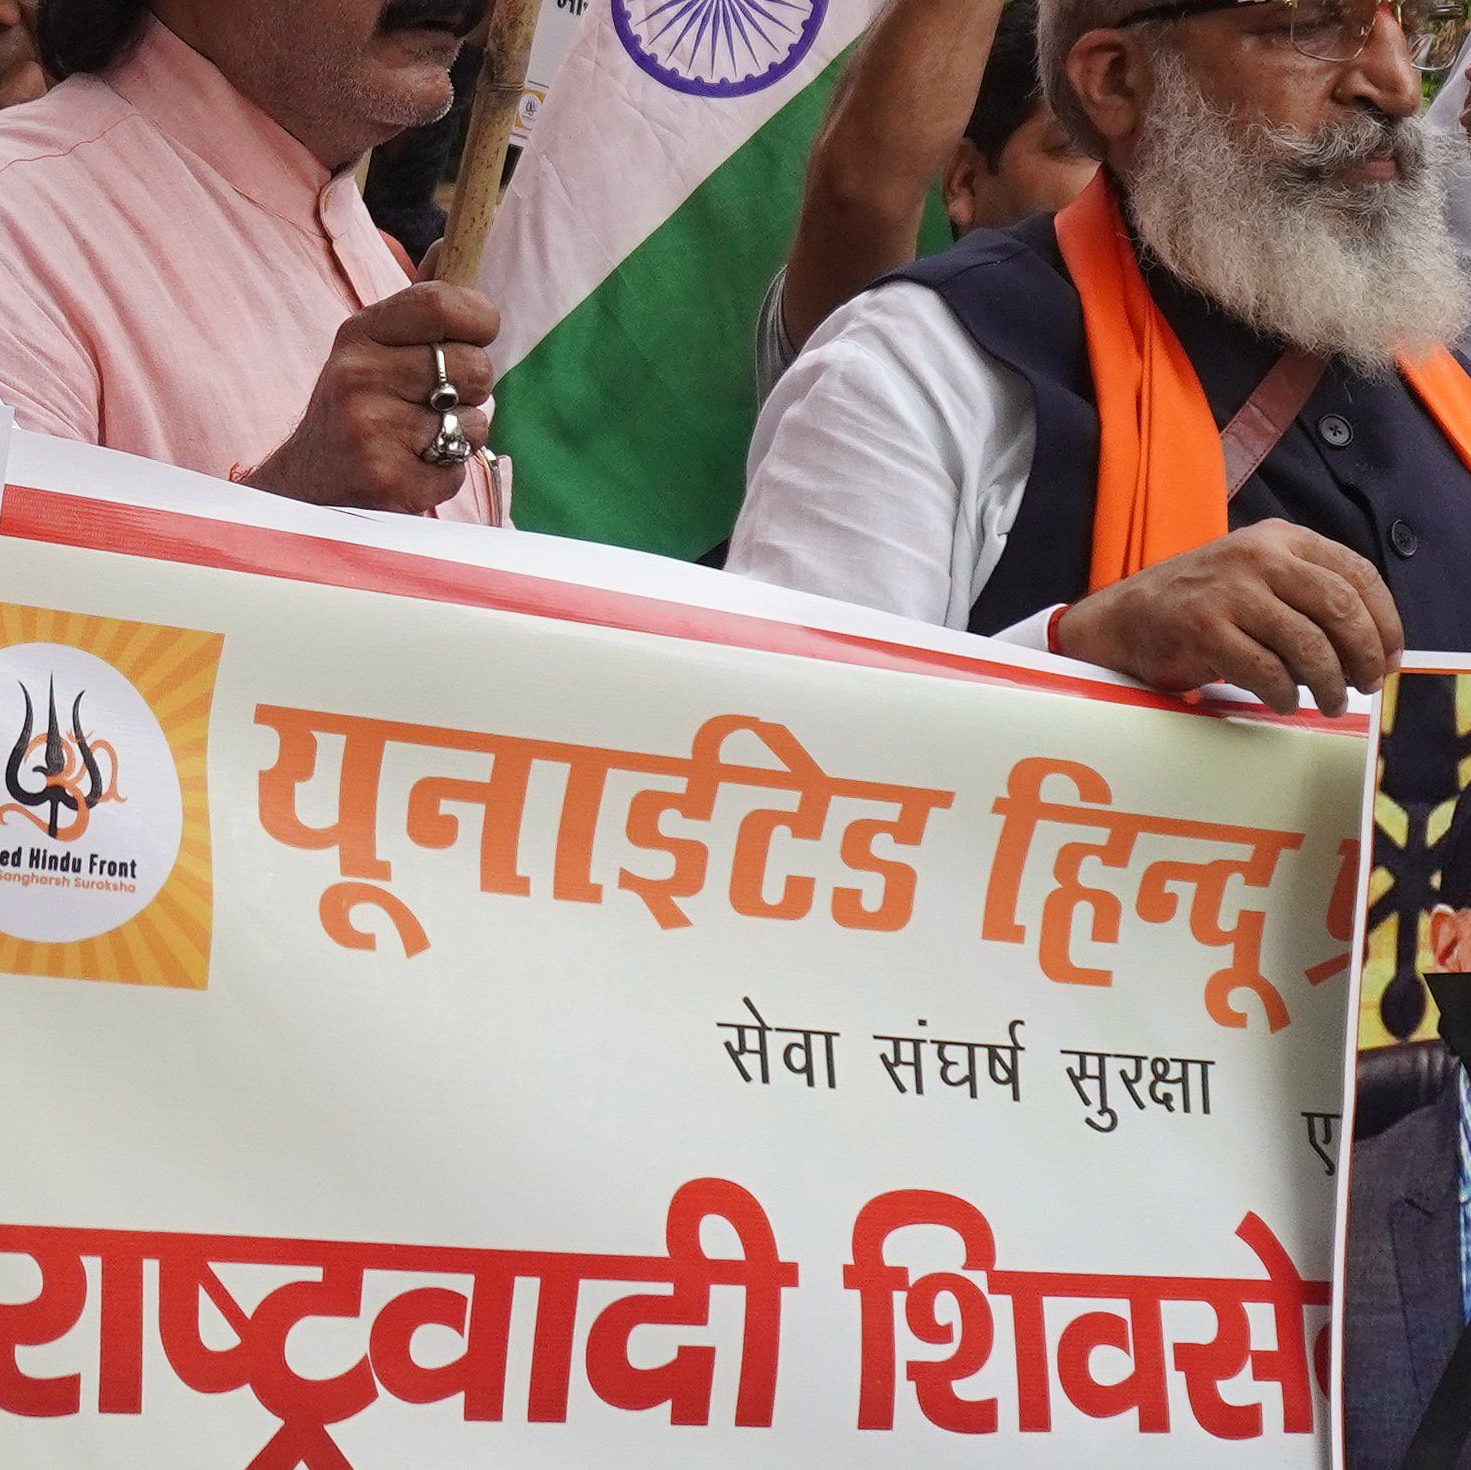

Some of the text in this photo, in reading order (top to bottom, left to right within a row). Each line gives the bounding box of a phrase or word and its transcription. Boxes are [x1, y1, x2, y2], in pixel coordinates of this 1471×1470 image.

[29, 847, 82, 874] Hindu
[88, 853, 137, 880] Front
[979, 755, 1307, 1036] हिन्दू
[716, 997, 1217, 1135] सेवा संघर्ष सुरक्षा
[841, 1186, 1333, 1442] शिवसे
